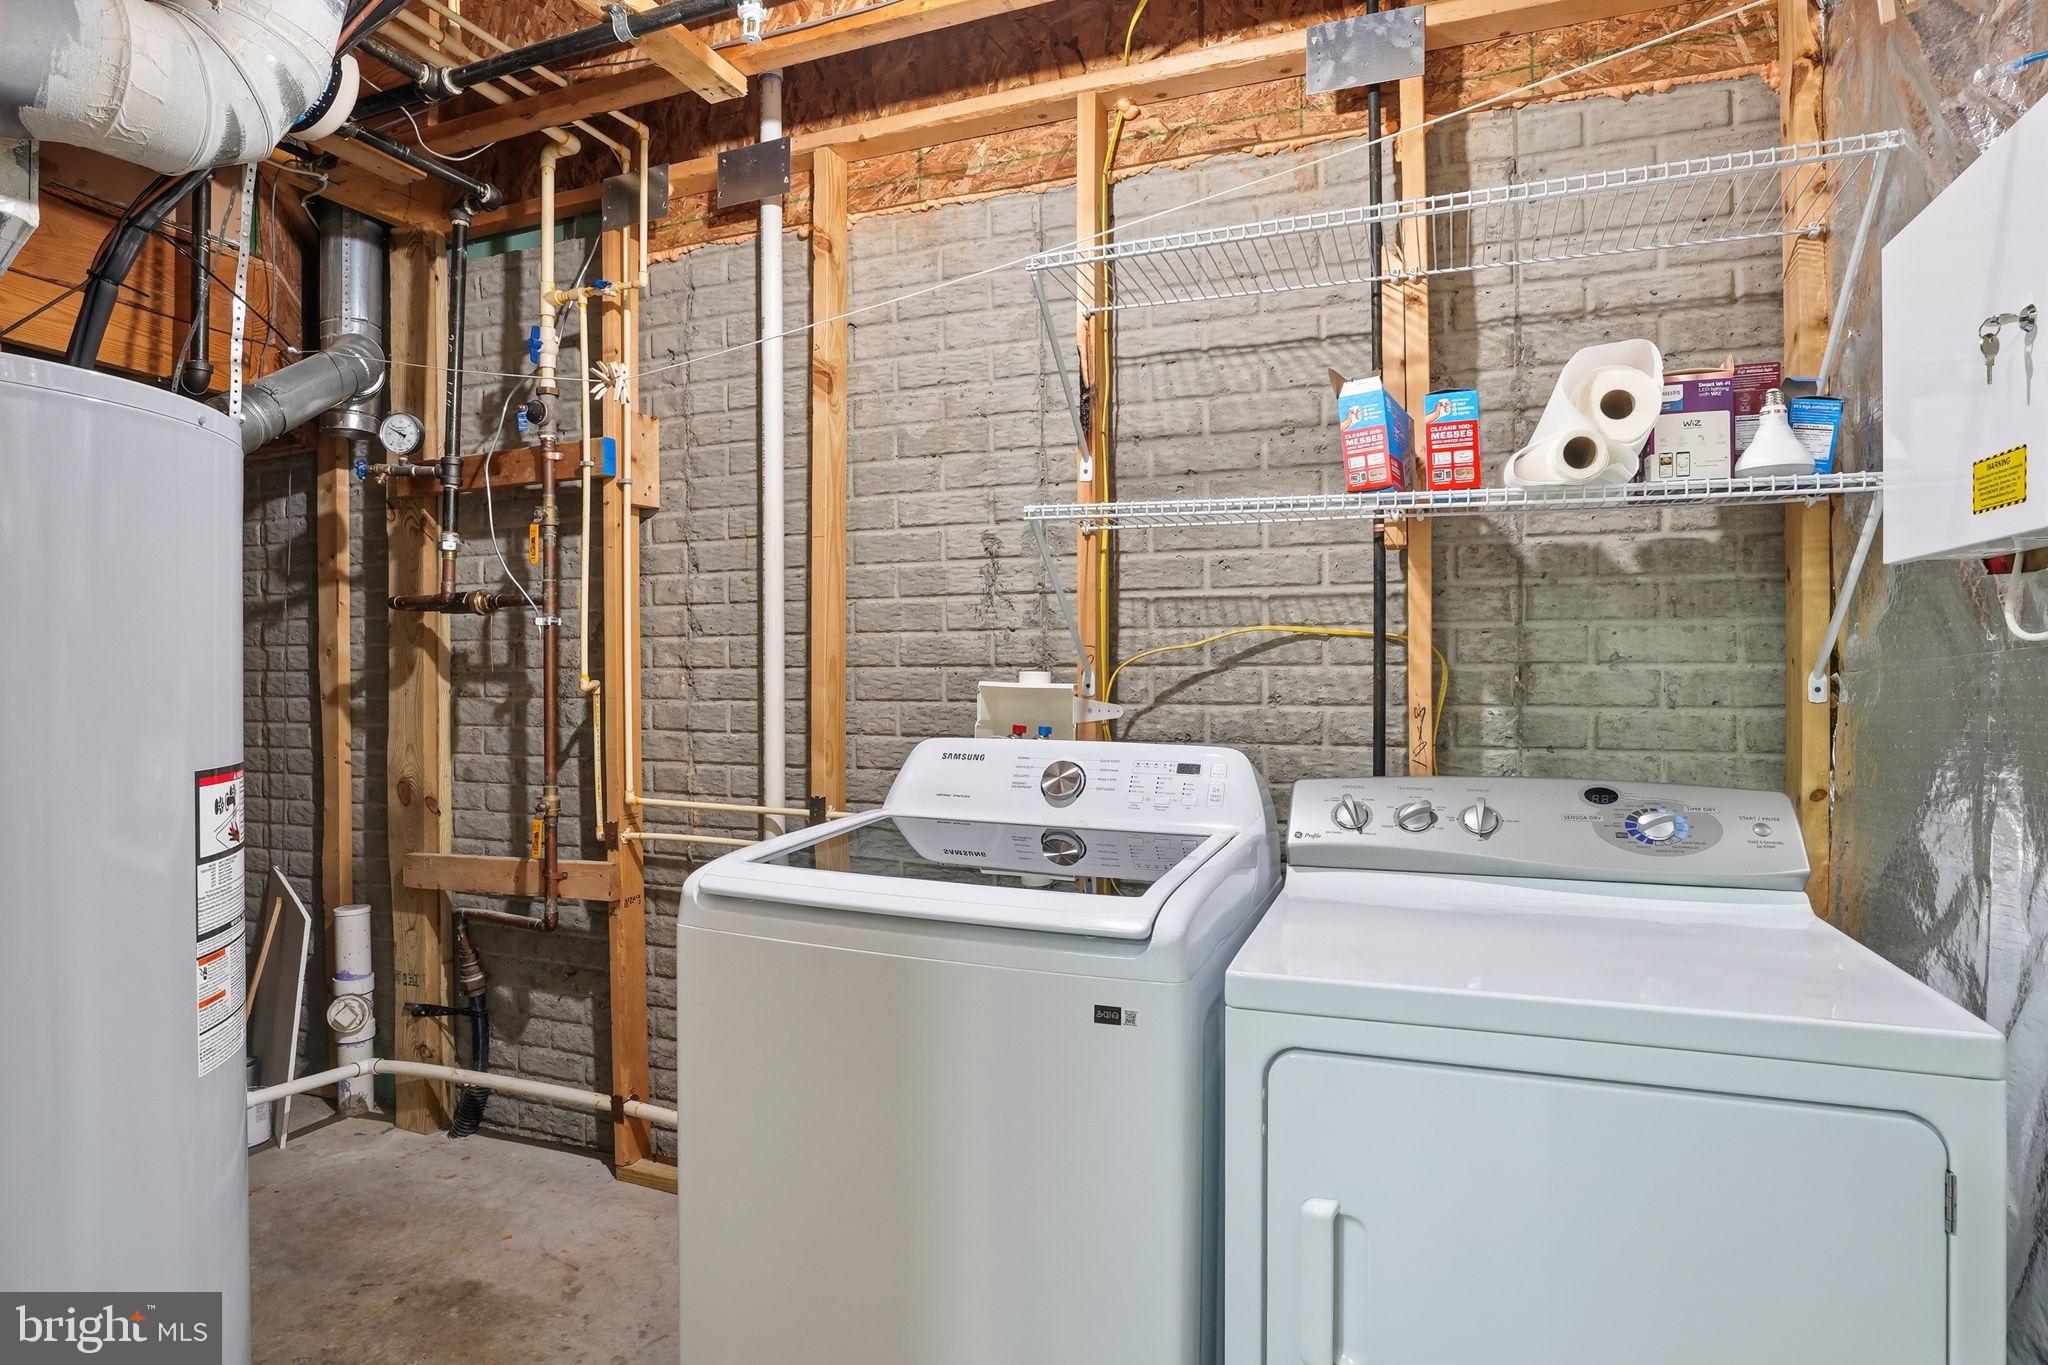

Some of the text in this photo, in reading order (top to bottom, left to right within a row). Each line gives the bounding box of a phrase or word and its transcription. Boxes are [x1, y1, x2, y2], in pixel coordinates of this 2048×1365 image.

[1345, 433, 1384, 447] MESSES
[1430, 430, 1473, 441] MESSES
[1986, 457, 2011, 471] WARNING
[942, 752, 986, 762] SAMSUNG
